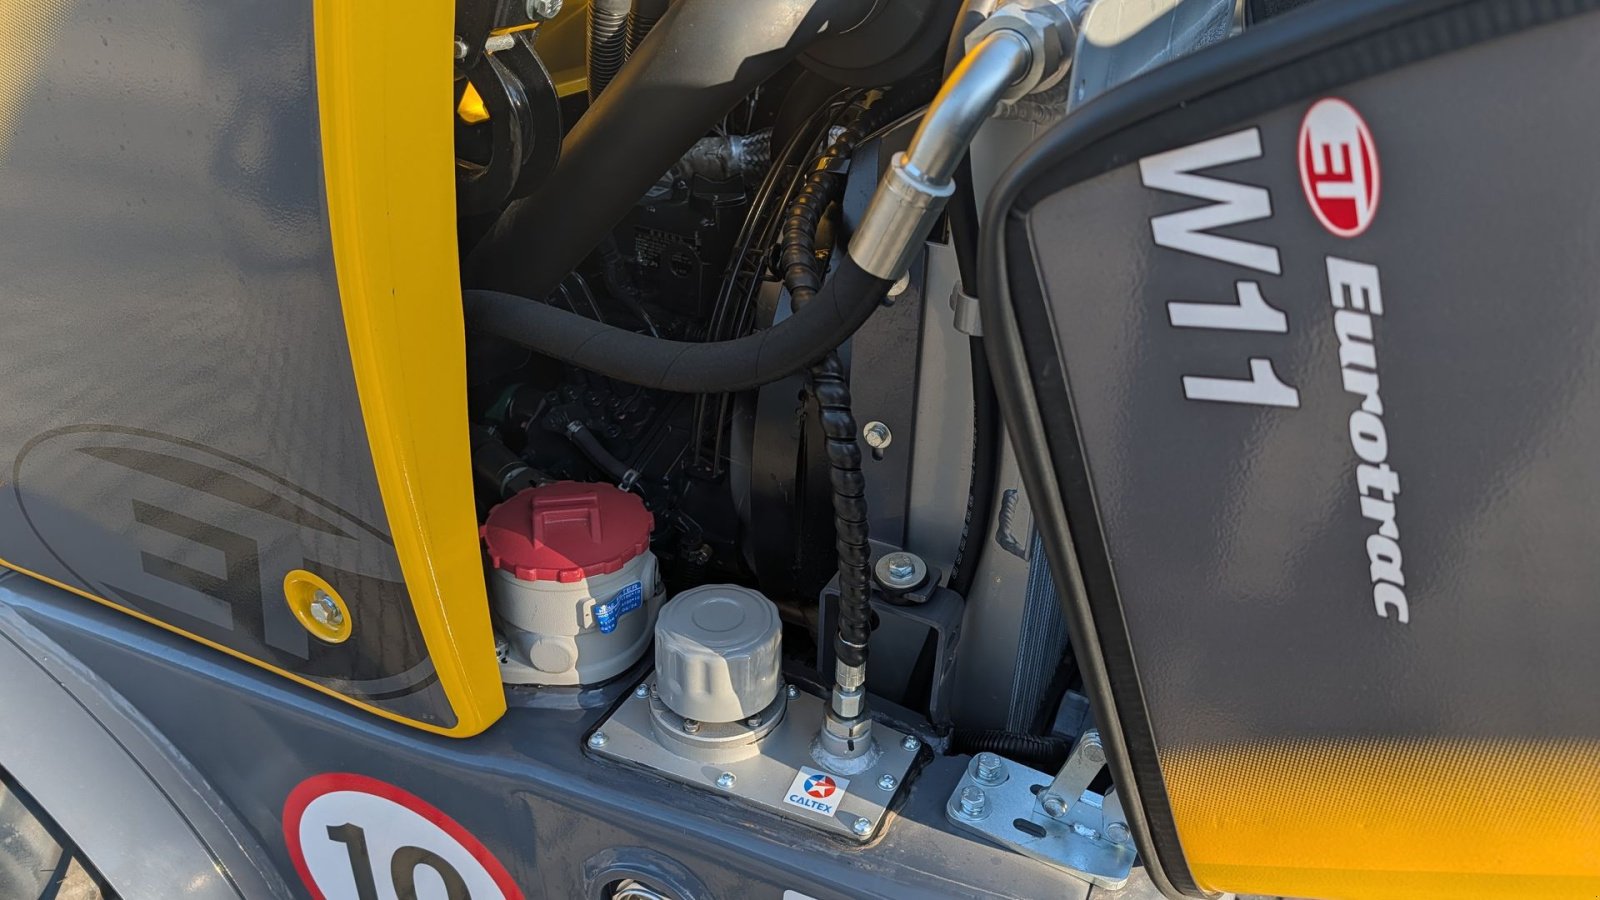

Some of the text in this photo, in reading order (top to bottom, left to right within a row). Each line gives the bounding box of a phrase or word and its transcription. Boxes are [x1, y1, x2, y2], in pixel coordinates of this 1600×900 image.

[1138, 126, 1301, 408] W11
[1302, 103, 1410, 624] ET Eurotrac
[789, 794, 834, 813] CALTEX
